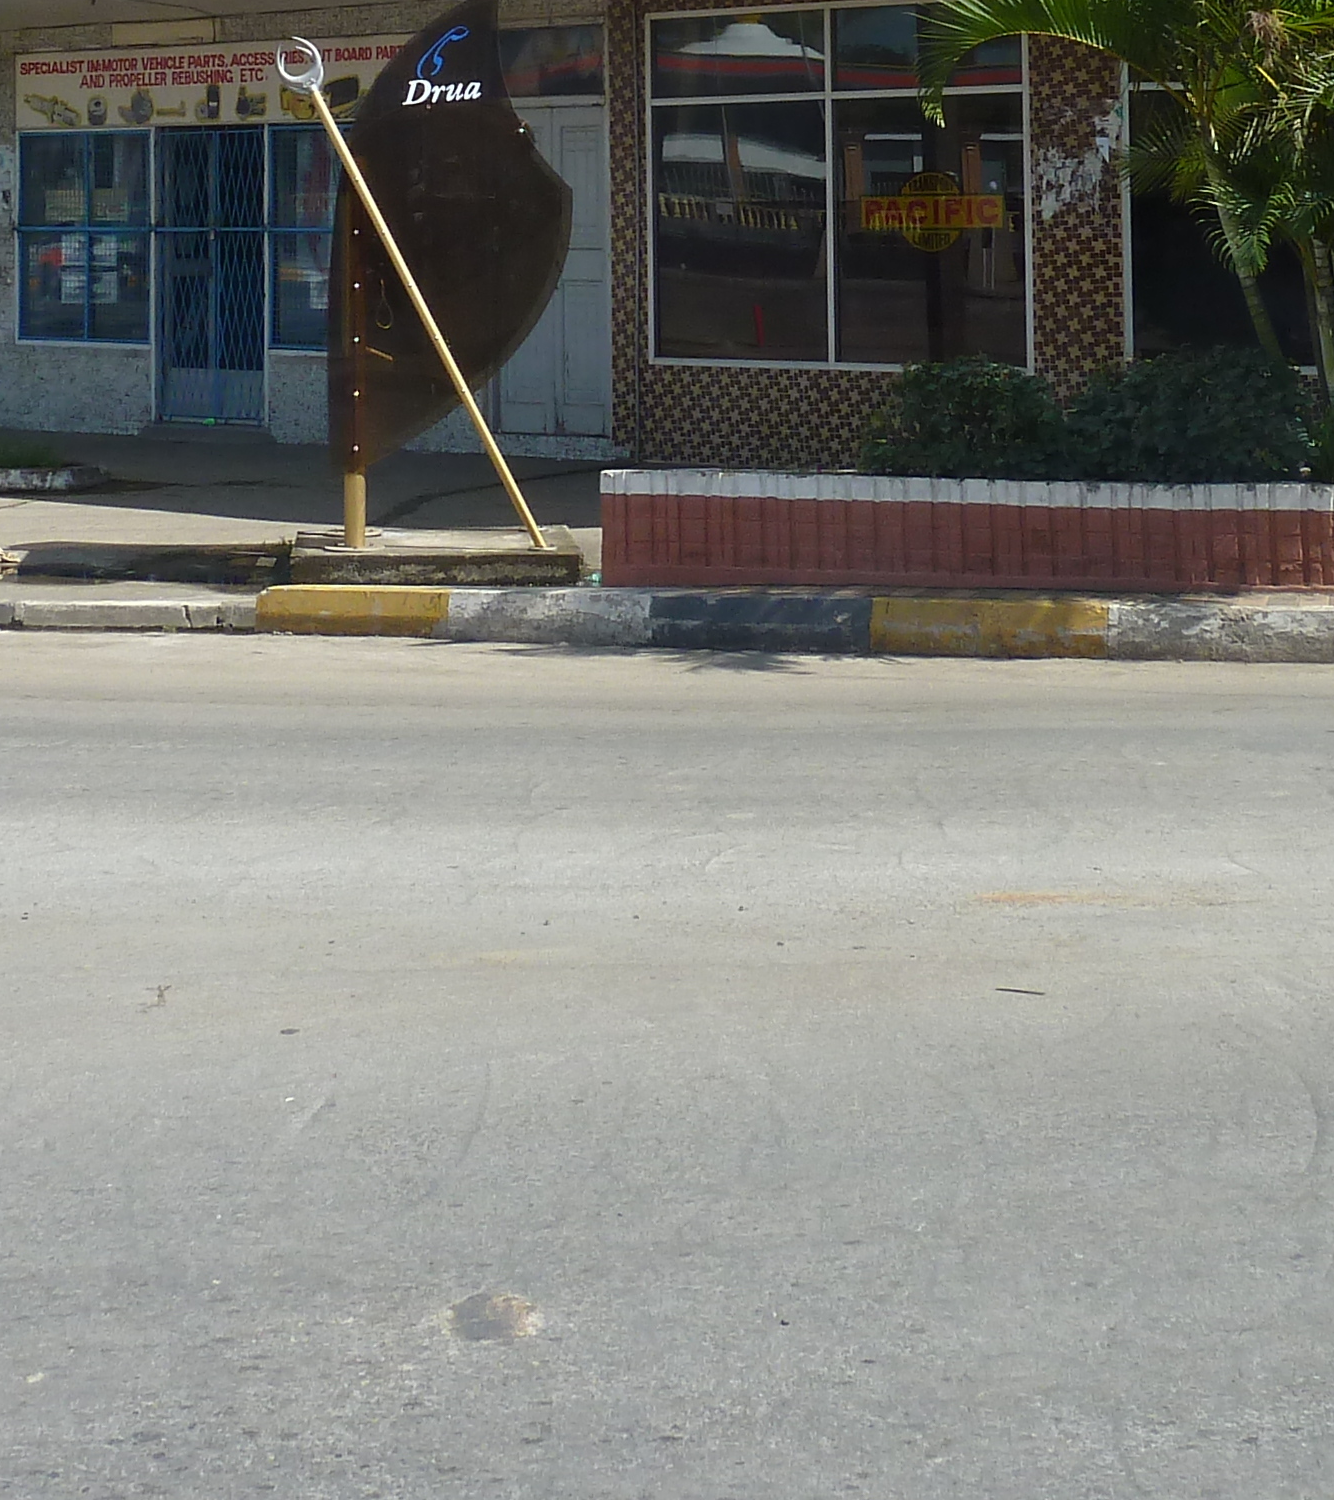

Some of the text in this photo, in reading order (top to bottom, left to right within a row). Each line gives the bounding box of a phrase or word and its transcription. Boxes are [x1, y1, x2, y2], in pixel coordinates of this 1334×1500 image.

[20, 60, 85, 76] SPECIALIST
[141, 56, 185, 71] VEHICLE
[335, 47, 372, 62] BOARD
[79, 73, 105, 89] AND
[109, 71, 167, 89] PROPELLER
[172, 69, 233, 86] REBUSHING
[401, 79, 482, 106] Drua
[865, 198, 999, 226] PACIFIC
